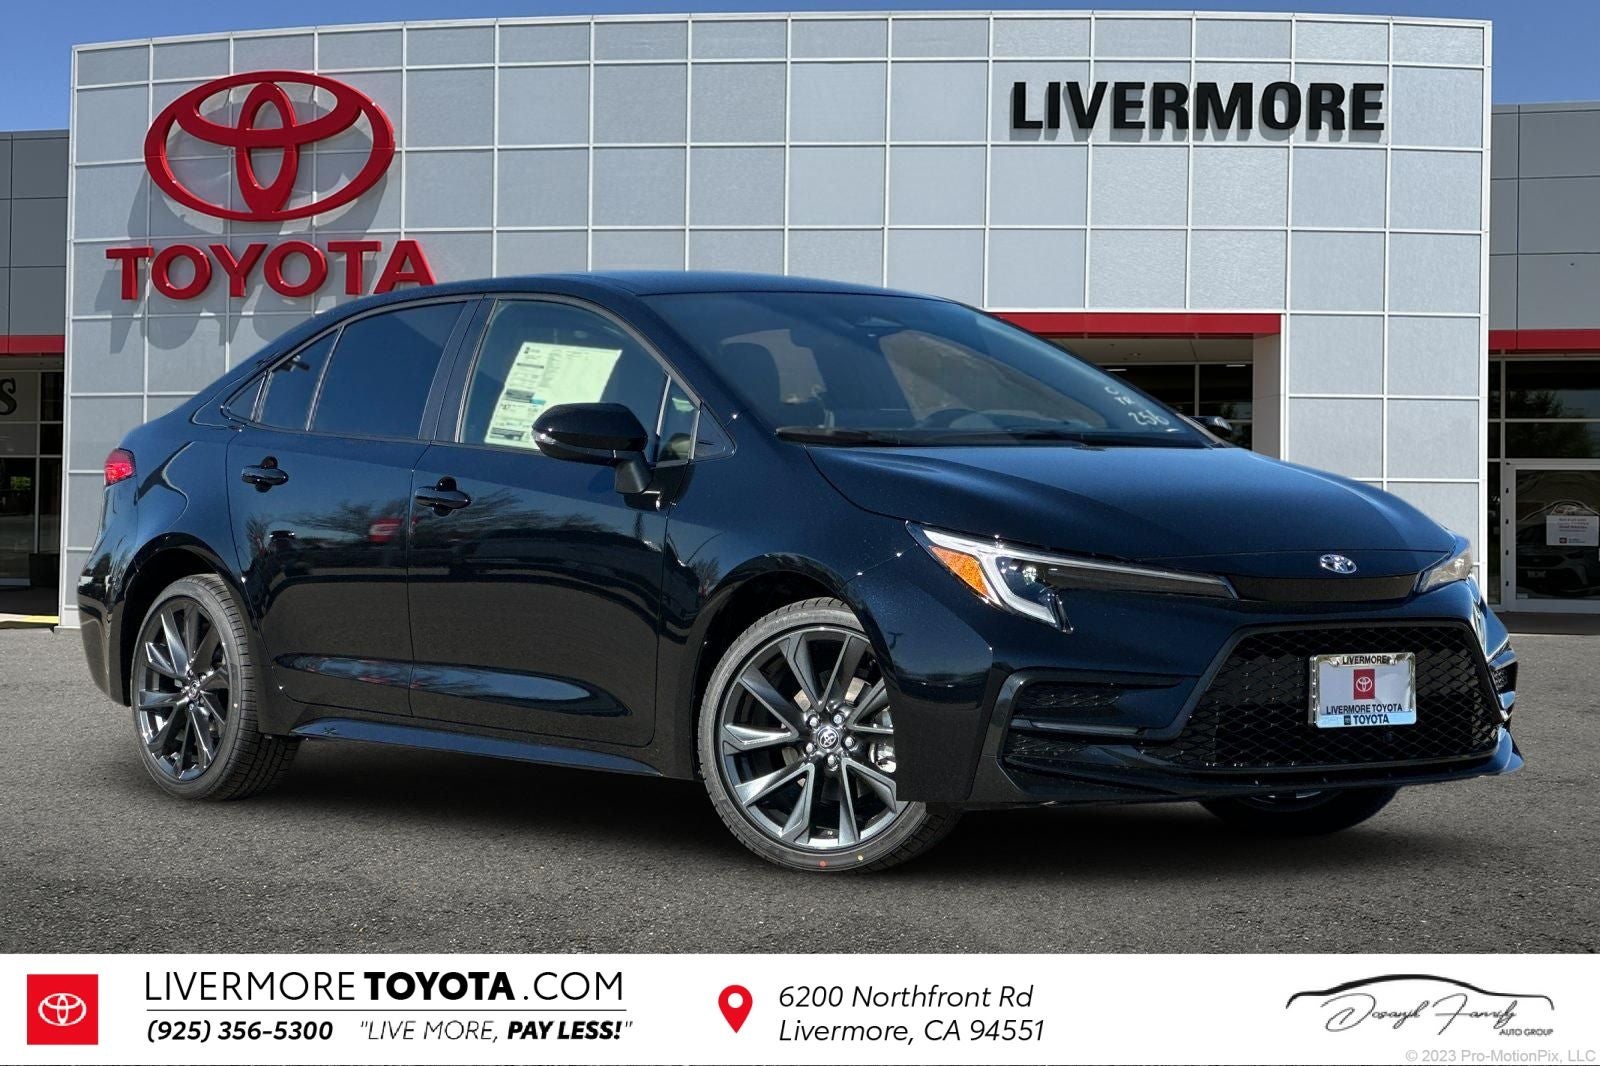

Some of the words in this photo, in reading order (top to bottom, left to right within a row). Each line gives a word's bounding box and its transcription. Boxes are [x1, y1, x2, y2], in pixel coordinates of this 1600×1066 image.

[1012, 81, 1385, 131] LIVERMORE
[106, 239, 437, 300] TOYOTA
[1341, 655, 1388, 666] LIVERMORE
[1326, 704, 1371, 715] LIVERMORE
[1371, 703, 1403, 713] TOYOTA
[1353, 713, 1390, 725] TOYOTA
